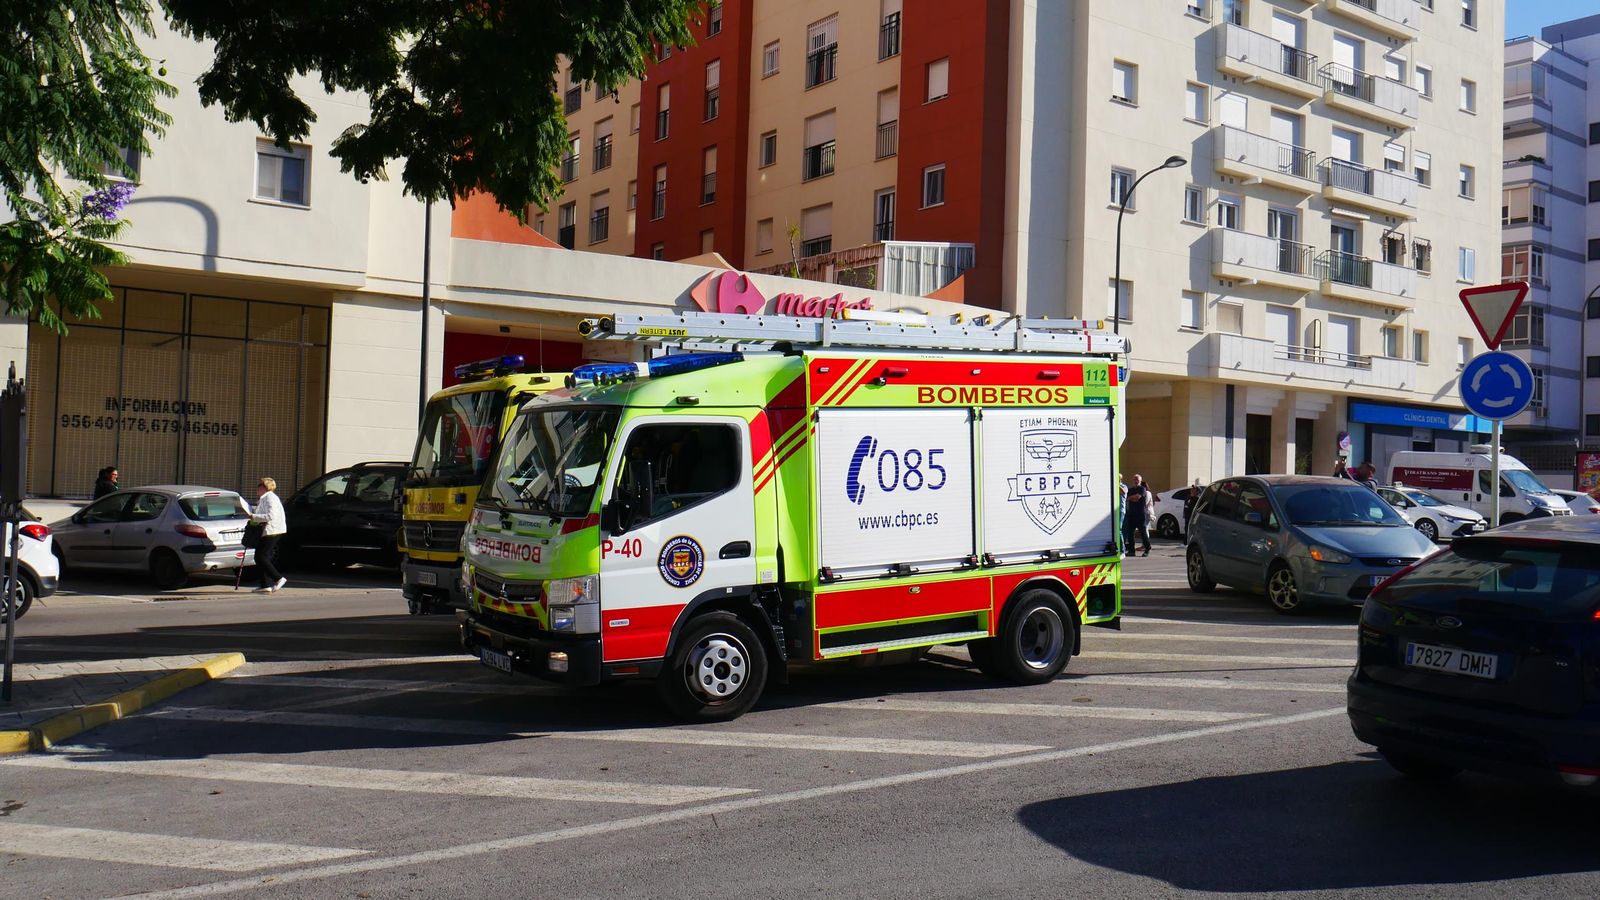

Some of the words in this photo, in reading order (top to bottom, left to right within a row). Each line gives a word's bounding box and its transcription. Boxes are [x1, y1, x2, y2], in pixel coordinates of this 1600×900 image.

[1086, 369, 1107, 381] 112
[918, 387, 1069, 404] BOMBEROS
[1019, 418, 1042, 428] ETIAM
[1048, 417, 1078, 428] PHOENIX
[1403, 411, 1425, 423] CLÍNICA
[1426, 415, 1447, 425] DENTAL
[877, 448, 947, 492] 085
[858, 510, 939, 530] www.cbpc.es
[601, 538, 642, 559] P-40
[1416, 646, 1453, 668] 7827
[1459, 653, 1493, 676] DMH
